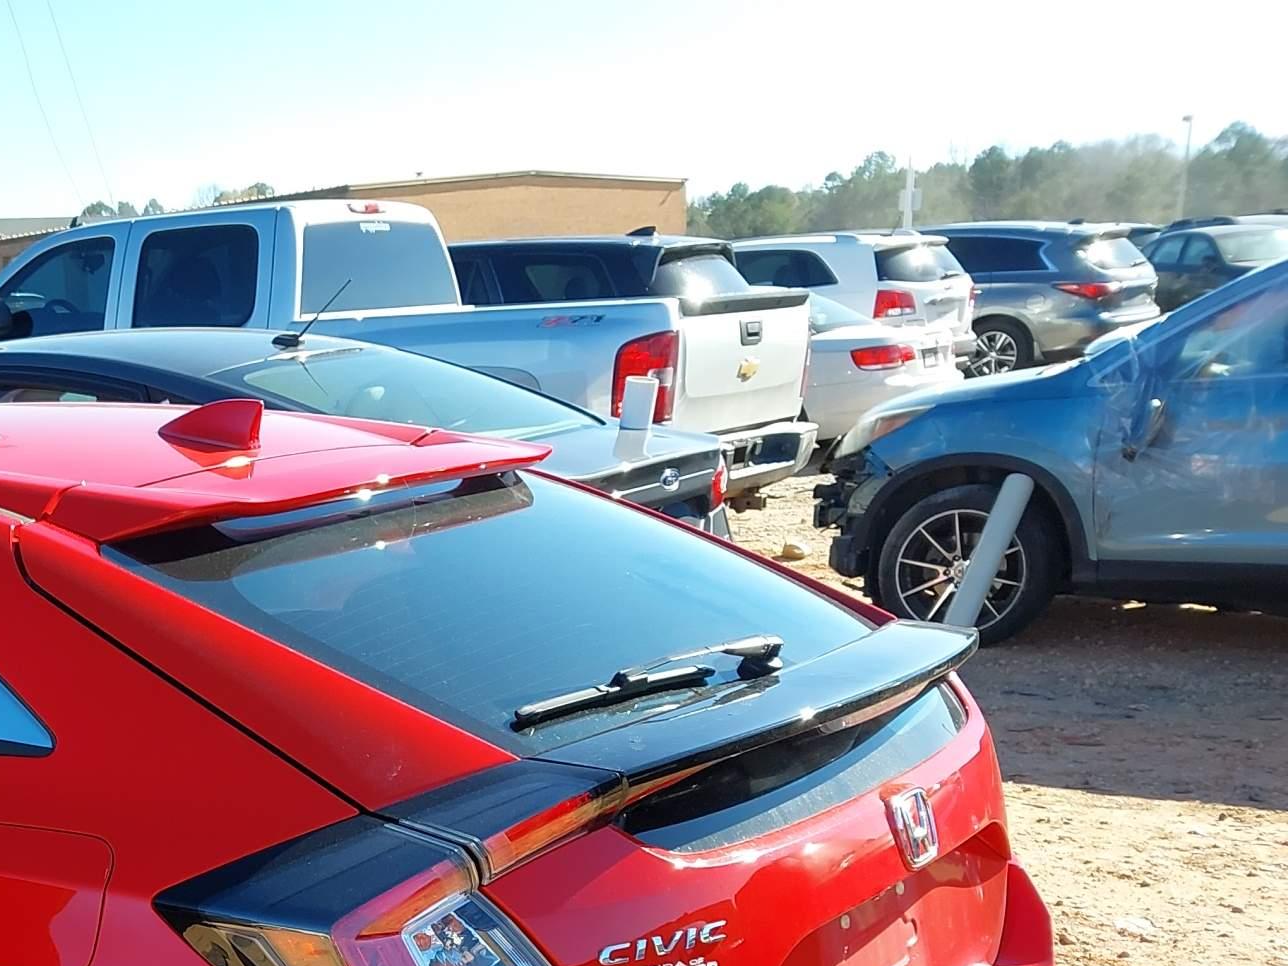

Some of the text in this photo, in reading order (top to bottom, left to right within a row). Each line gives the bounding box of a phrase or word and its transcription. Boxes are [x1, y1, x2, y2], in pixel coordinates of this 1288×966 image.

[536, 314, 607, 328] Z71
[599, 920, 727, 966] CIVIC
[689, 957, 705, 966] OF
